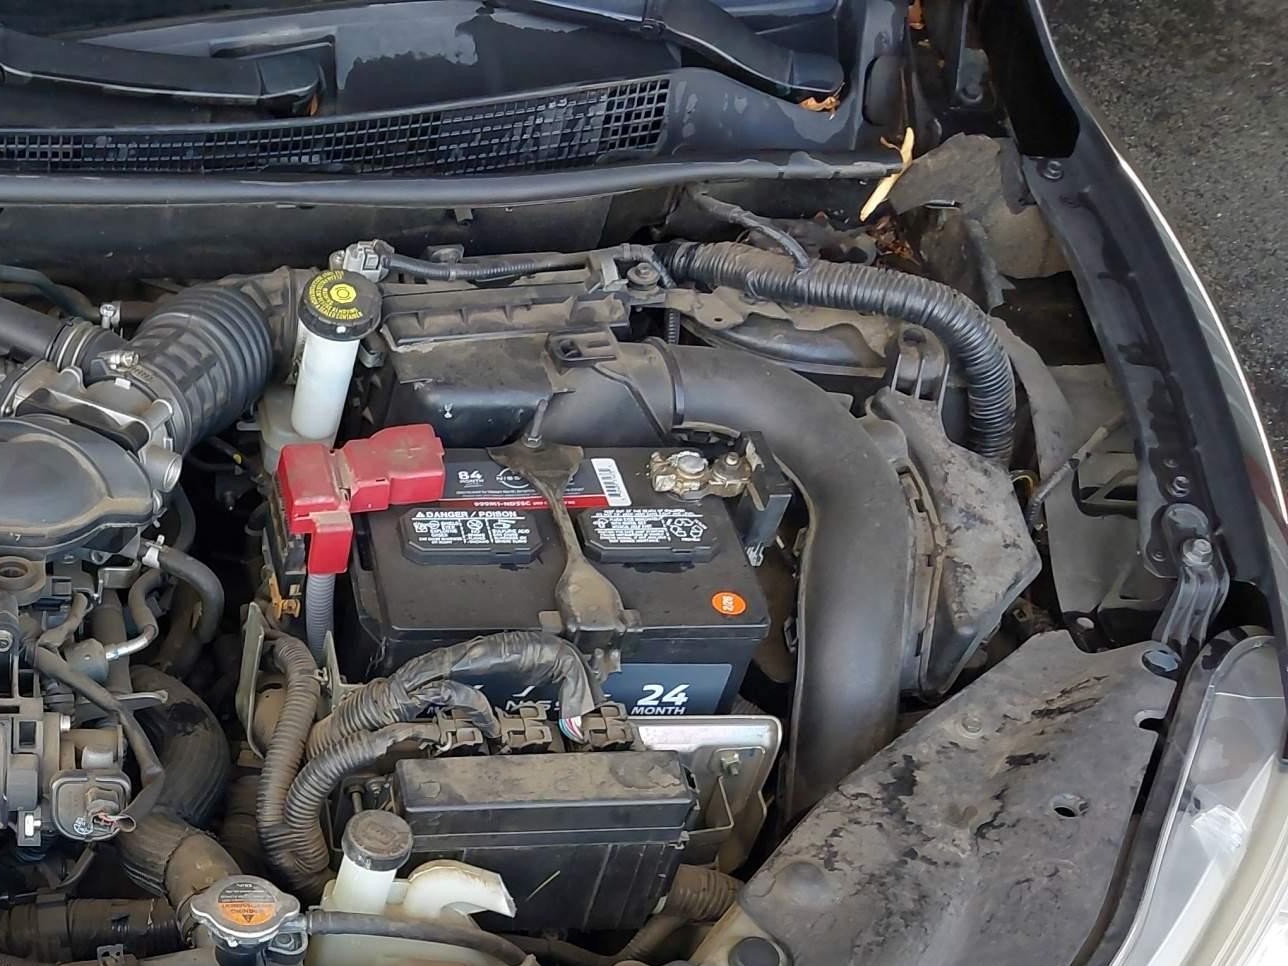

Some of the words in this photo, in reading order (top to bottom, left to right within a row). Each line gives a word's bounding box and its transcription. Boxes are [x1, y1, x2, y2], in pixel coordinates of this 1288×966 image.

[458, 470, 482, 480] 84
[478, 510, 517, 518] POISON
[636, 684, 691, 706] 24
[631, 706, 686, 715] MONTH
